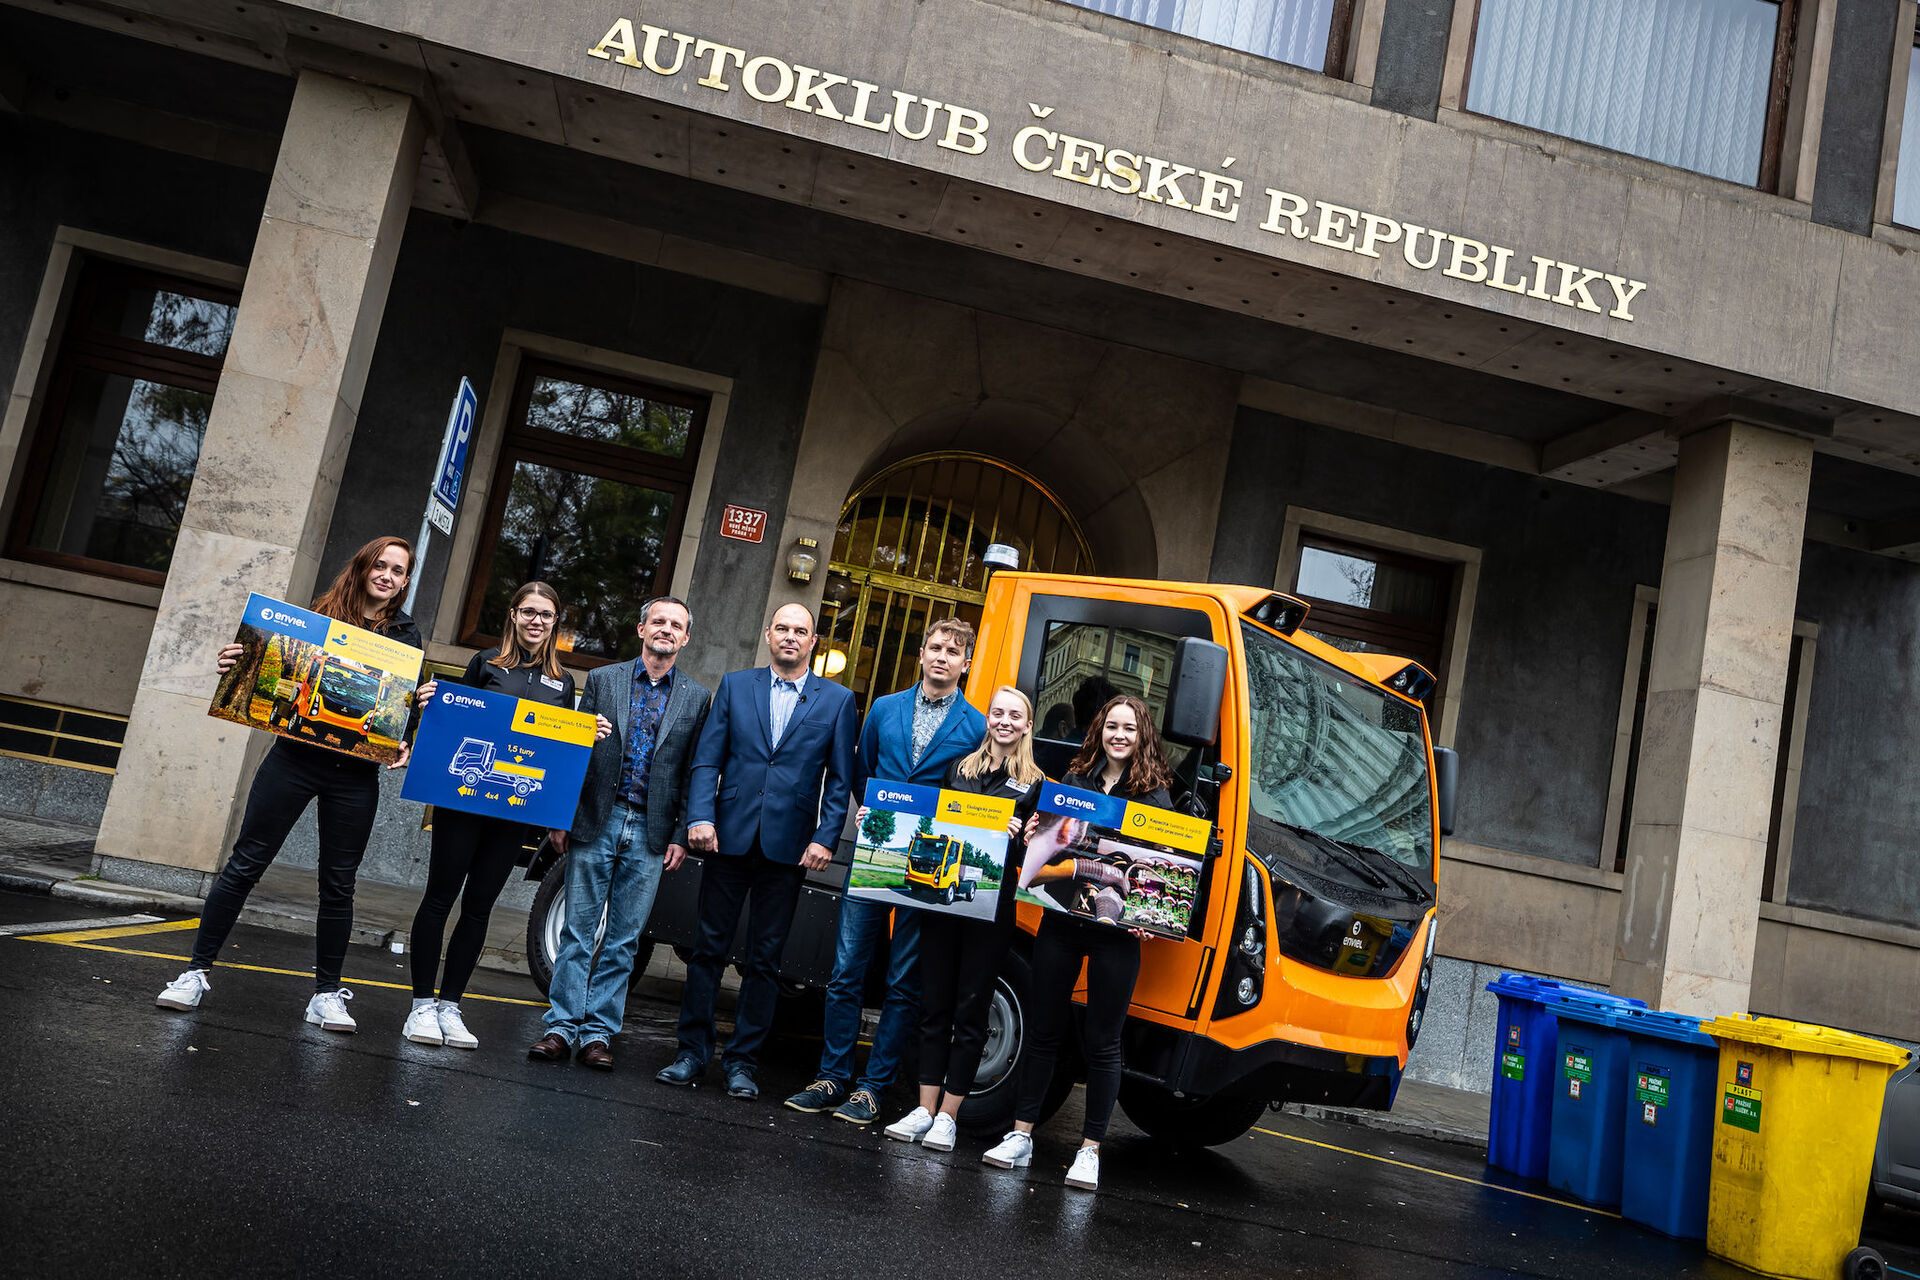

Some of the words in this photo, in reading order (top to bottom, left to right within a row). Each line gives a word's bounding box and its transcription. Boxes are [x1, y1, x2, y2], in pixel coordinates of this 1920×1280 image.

[587, 17, 990, 155] AUTOKLUB
[1011, 103, 1243, 222] ČESKÉ
[1259, 187, 1647, 322] REPUBLIKY
[450, 399, 472, 463] P
[728, 509, 762, 526] 1337
[507, 744, 517, 755] 1,5
[518, 747, 535, 757] tuny
[484, 791, 499, 801] 4x4
[1733, 1086, 1753, 1097] PLAST
